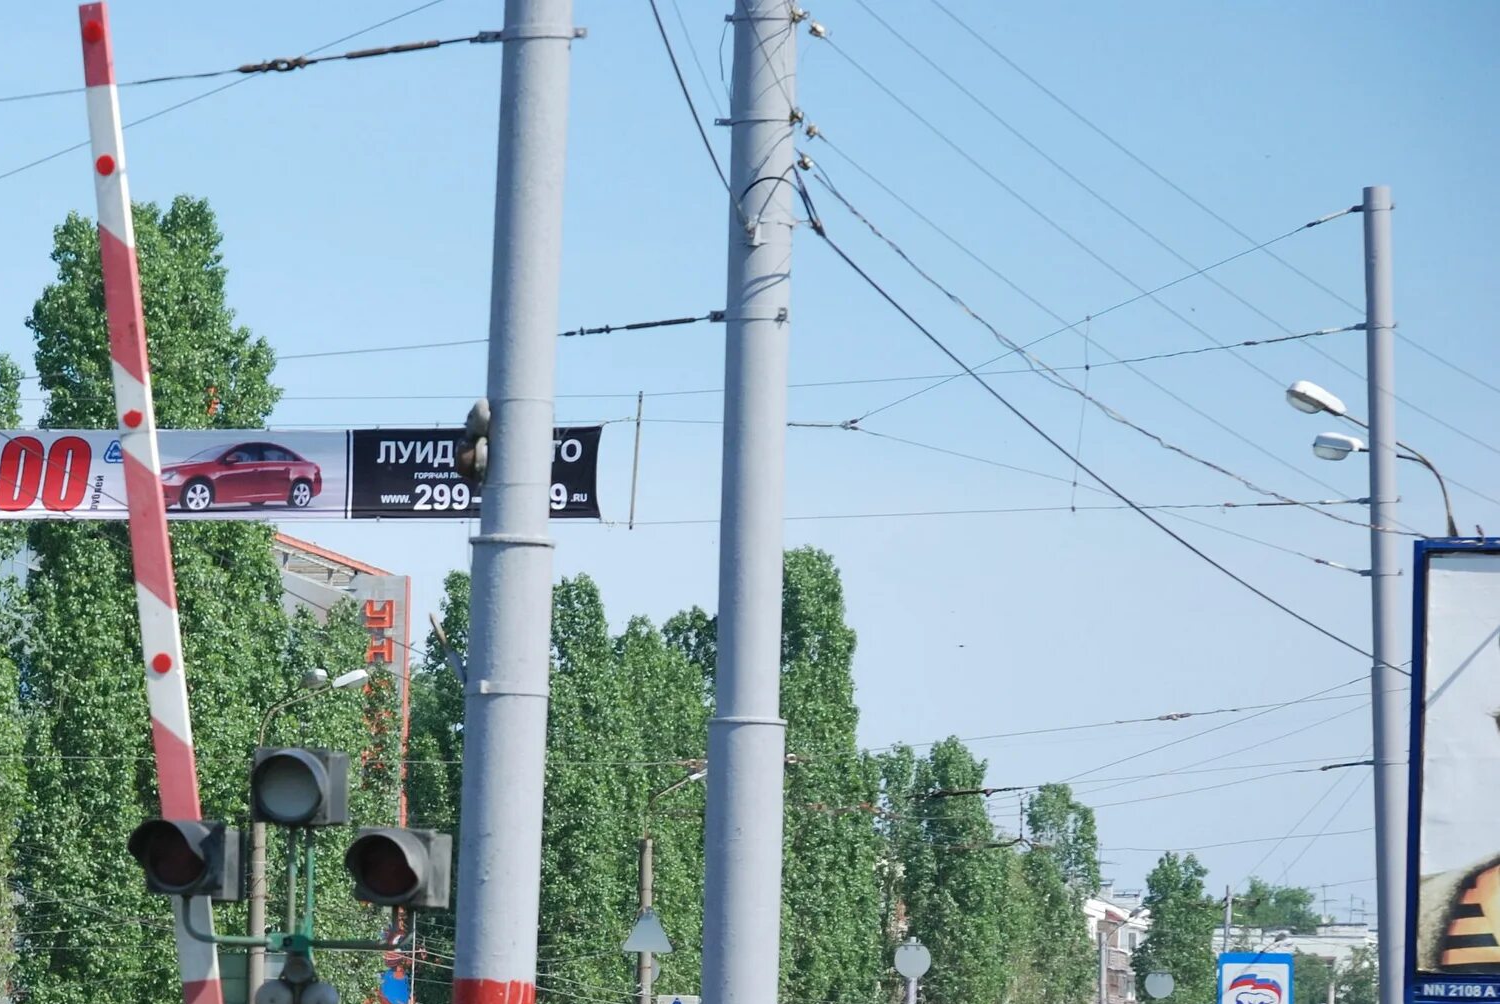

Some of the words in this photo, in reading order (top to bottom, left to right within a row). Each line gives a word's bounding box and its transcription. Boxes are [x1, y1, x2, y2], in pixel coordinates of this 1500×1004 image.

[376, 440, 456, 468] ЛУИД
[413, 471, 449, 480] ГОРЯЧАЯ
[1423, 984, 1445, 996] NN
[1448, 985, 1481, 997] 2108
[1483, 985, 1496, 998] A
